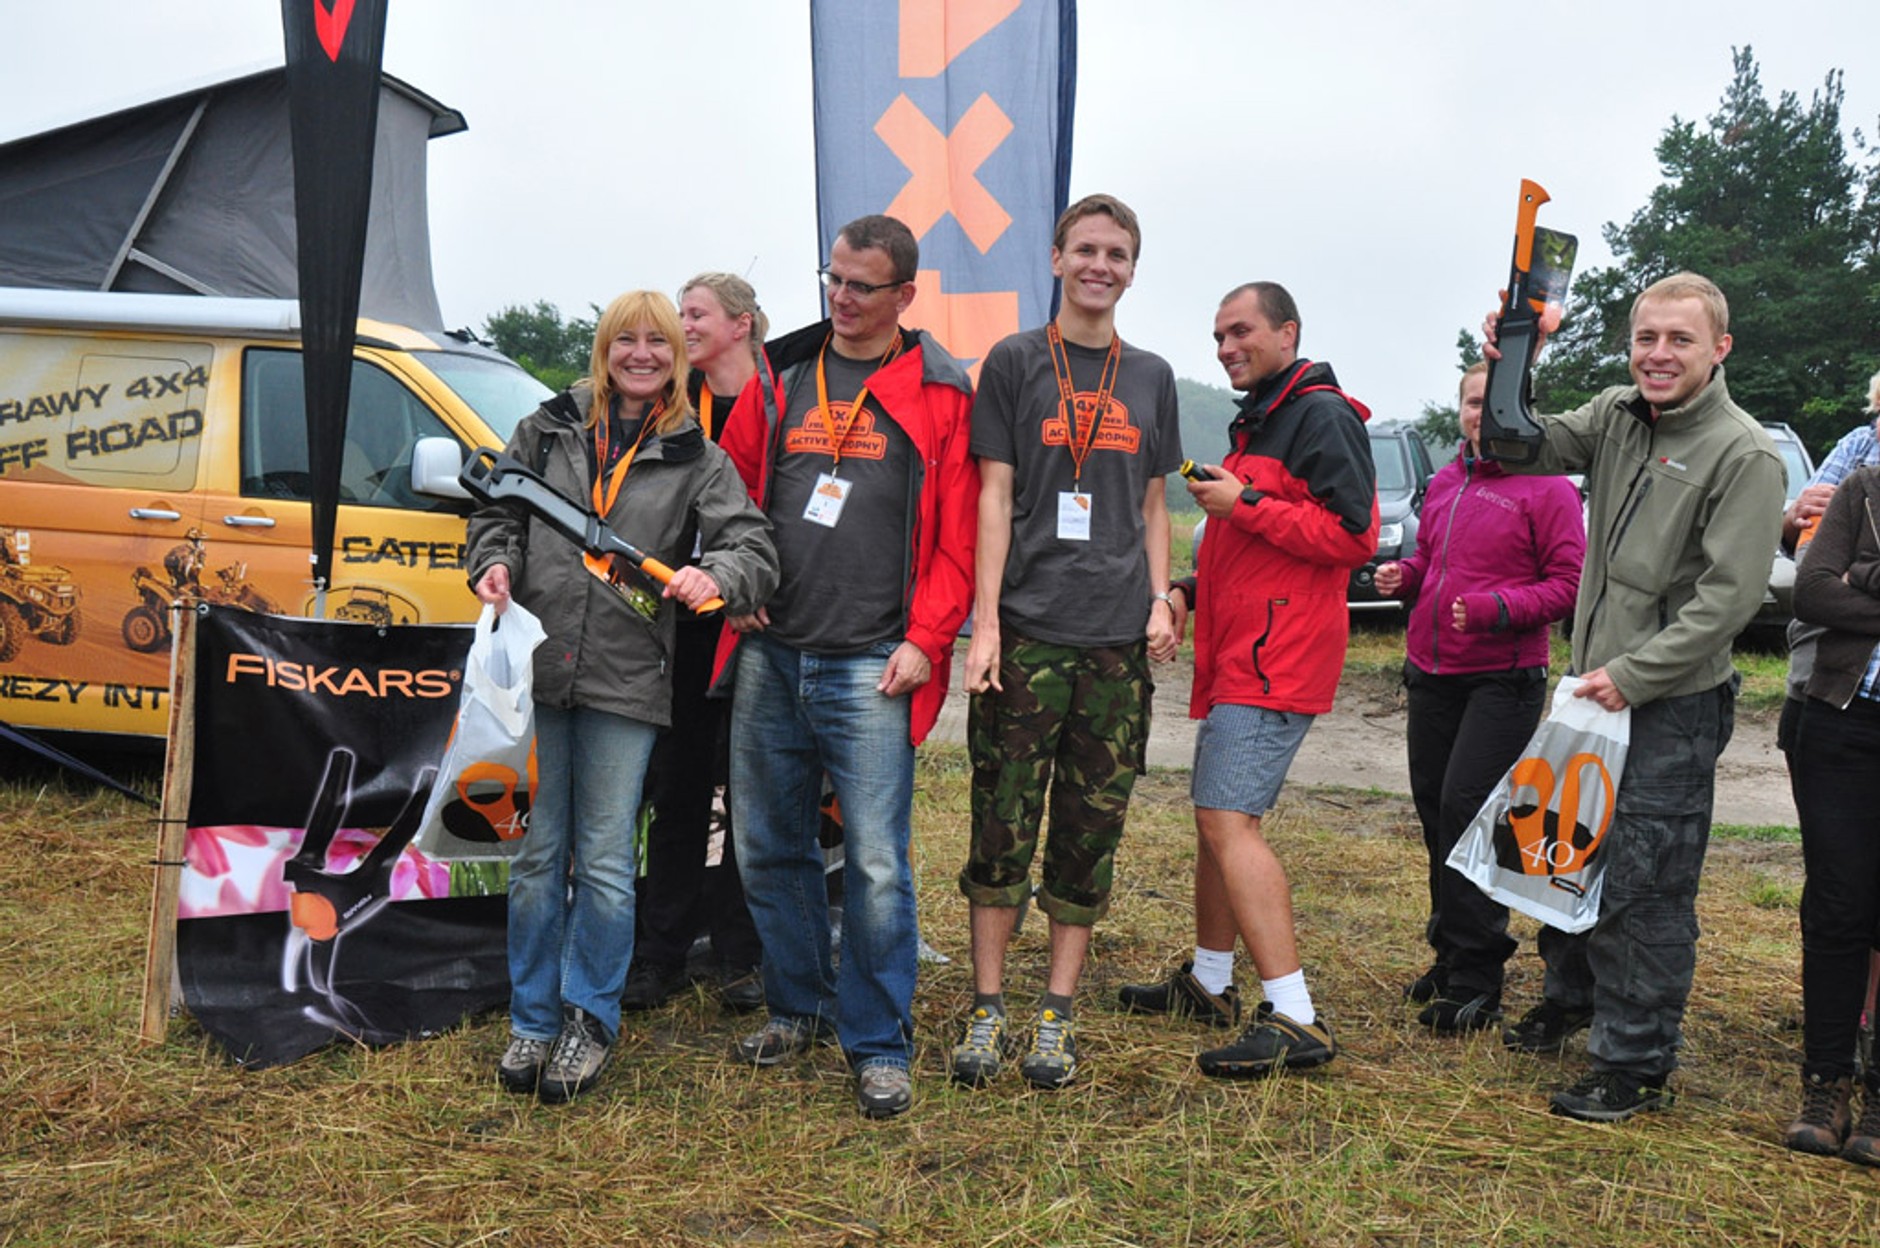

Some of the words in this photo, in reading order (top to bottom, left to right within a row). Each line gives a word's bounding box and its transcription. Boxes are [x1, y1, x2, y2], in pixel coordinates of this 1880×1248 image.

[125, 366, 209, 399] 4X4
[66, 409, 204, 459] ROAD
[1521, 836, 1575, 868] 40
